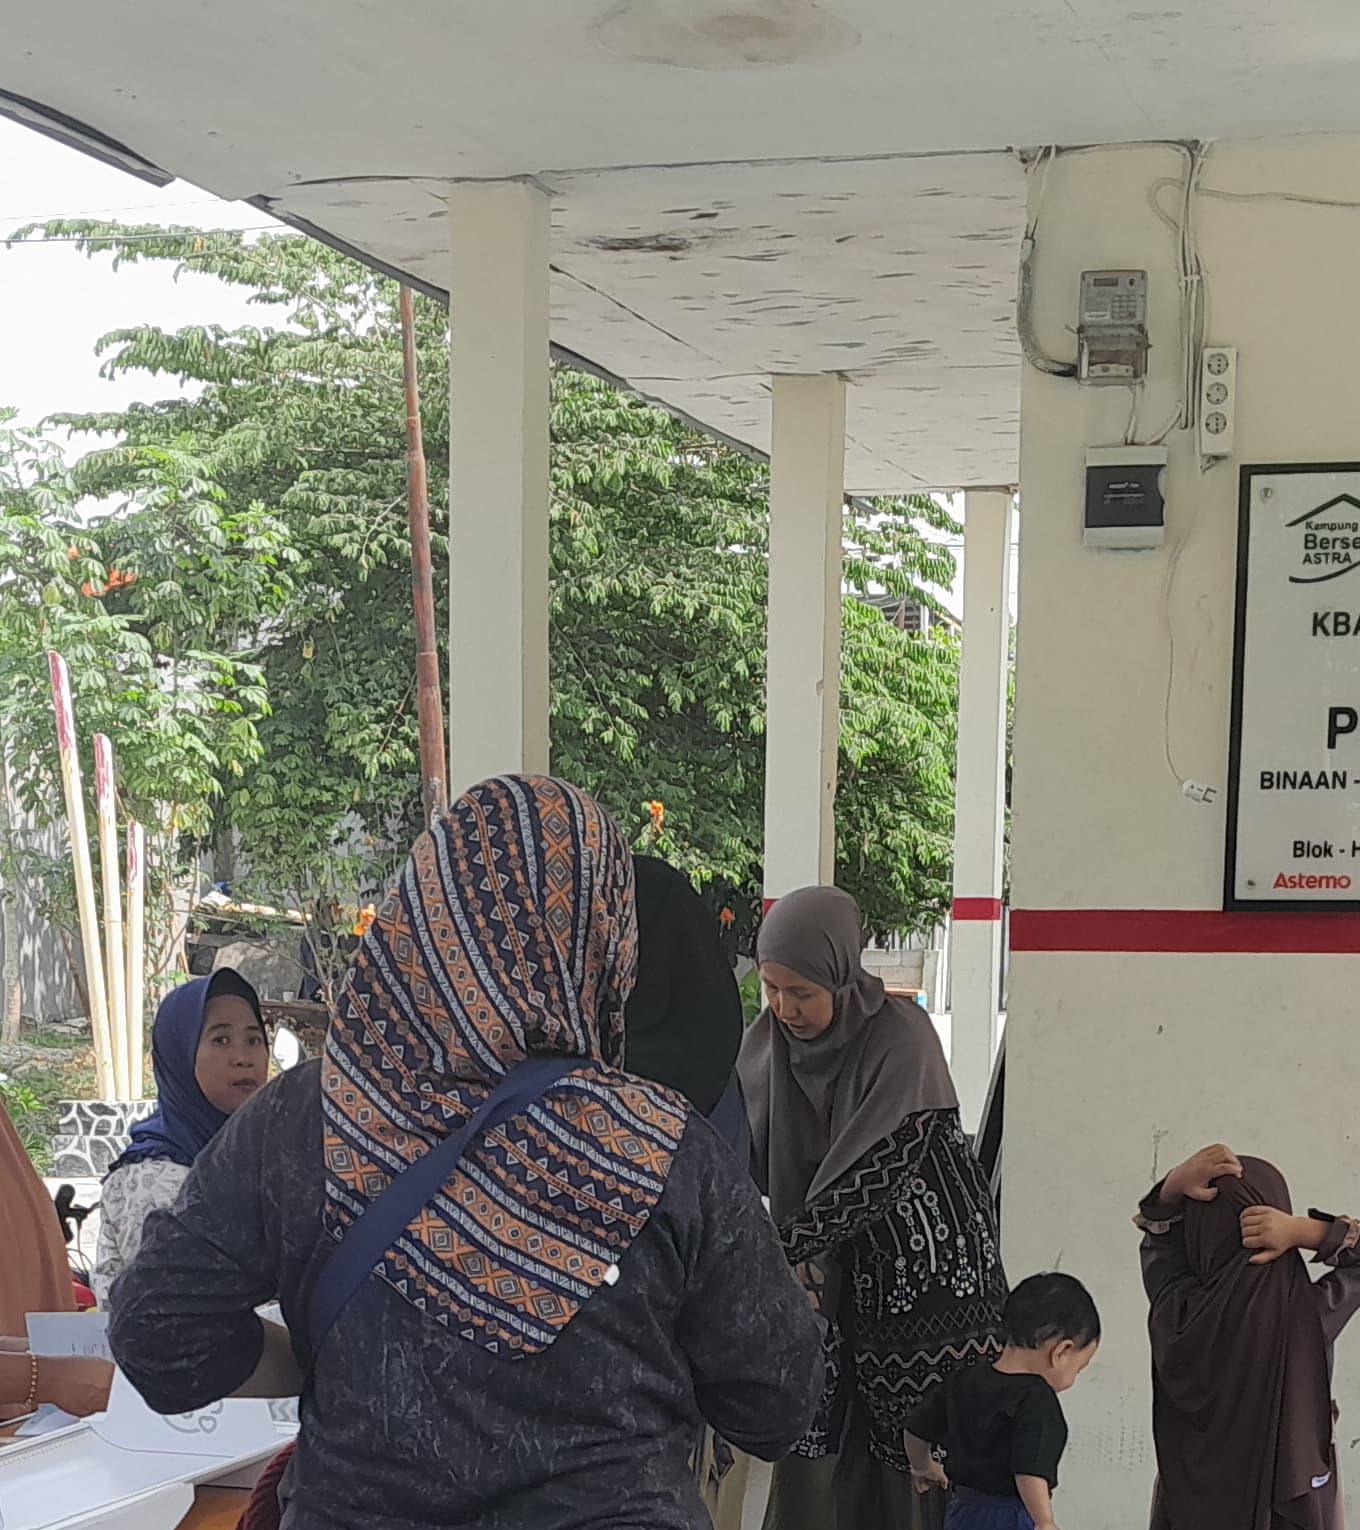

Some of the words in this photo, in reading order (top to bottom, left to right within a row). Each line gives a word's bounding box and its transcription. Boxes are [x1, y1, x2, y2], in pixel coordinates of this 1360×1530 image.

[1305, 521, 1359, 533] Kampung
[1302, 552, 1352, 565] ASTRA
[1259, 770, 1347, 790] BINAAN
[1292, 840, 1334, 858] Blok
[1273, 872, 1351, 889] Astemo
